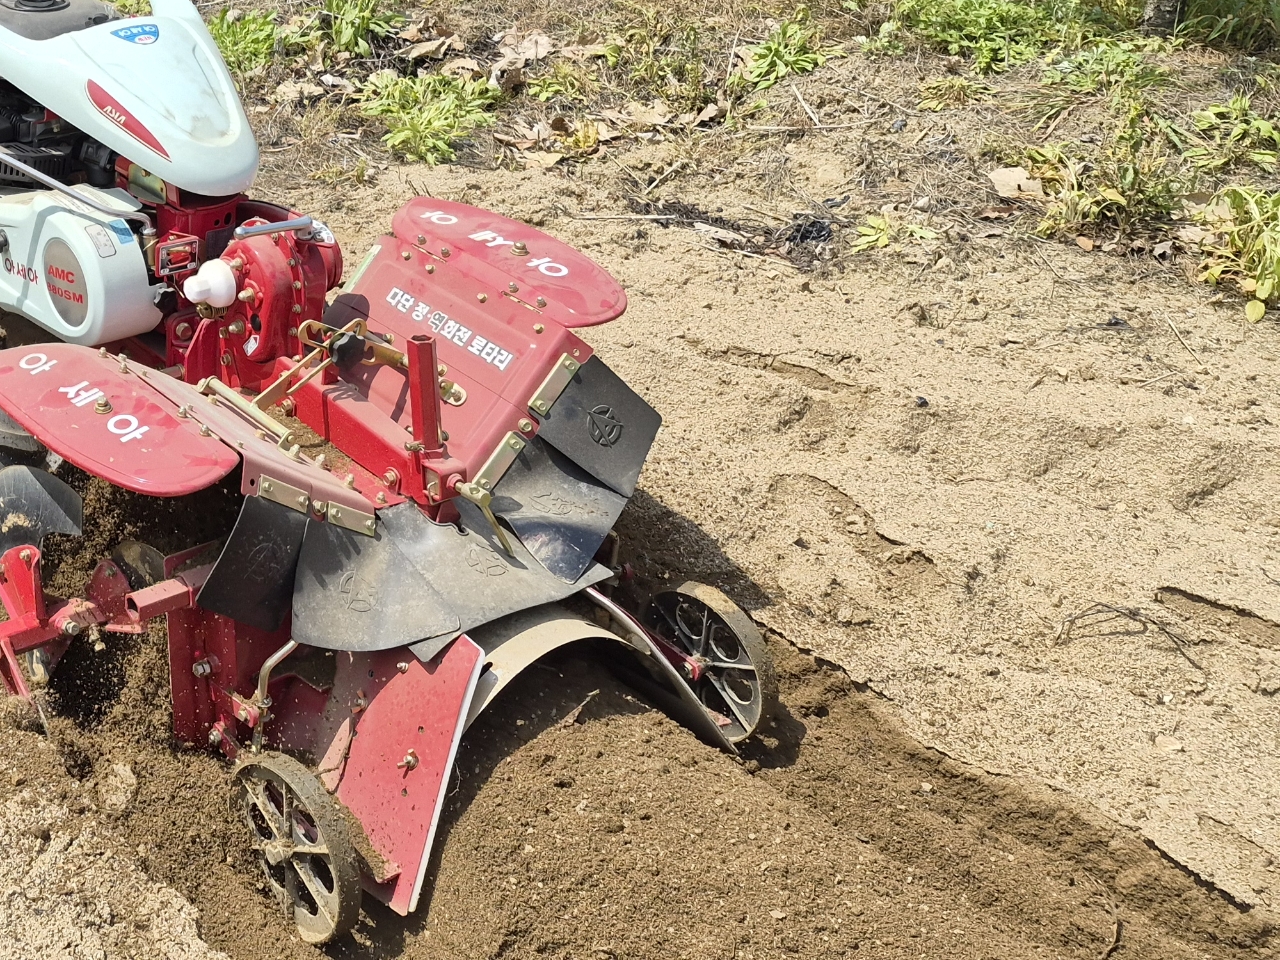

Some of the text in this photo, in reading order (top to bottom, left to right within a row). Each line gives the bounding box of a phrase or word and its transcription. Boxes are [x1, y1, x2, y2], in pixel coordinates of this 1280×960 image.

[103, 105, 127, 125] ASIA
[47, 264, 75, 284] AMC
[385, 286, 415, 313] 다단
[467, 334, 514, 373] 로타리
